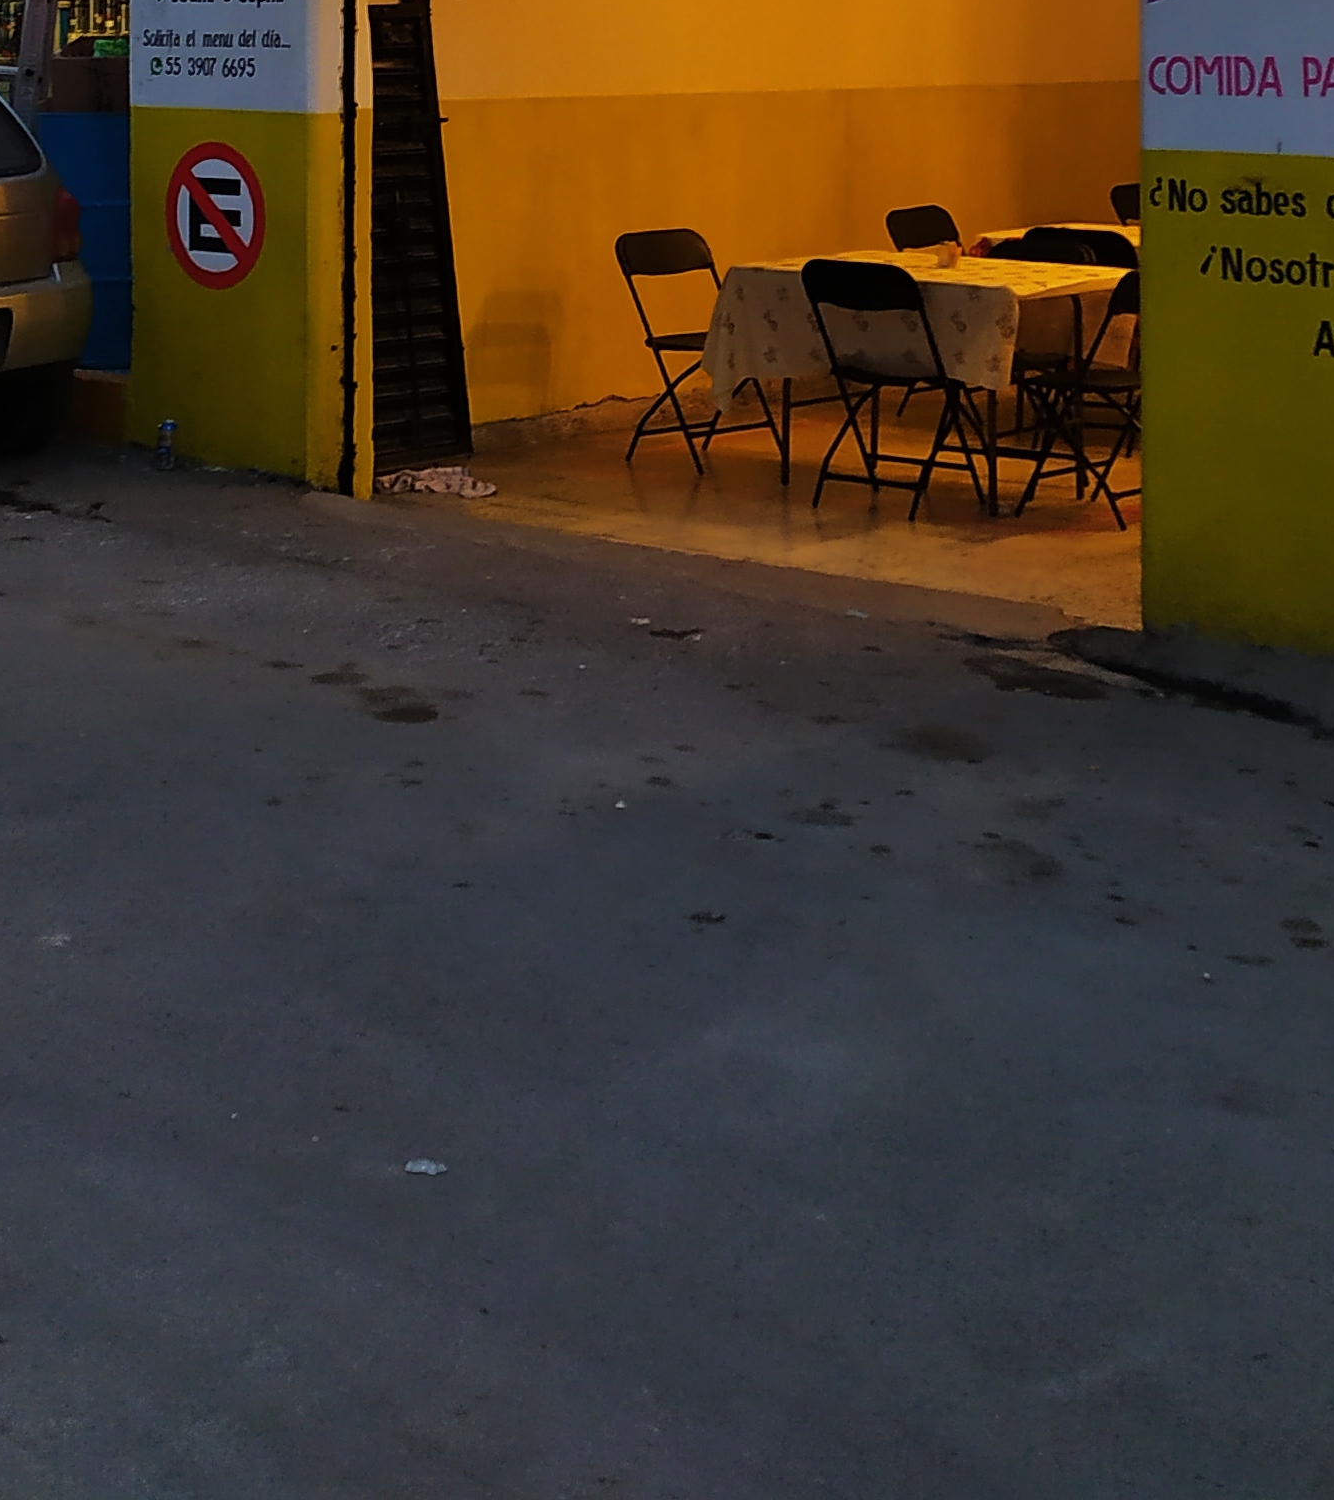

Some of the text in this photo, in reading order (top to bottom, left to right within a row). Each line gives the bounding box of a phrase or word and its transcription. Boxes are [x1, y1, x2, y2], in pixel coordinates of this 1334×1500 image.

[142, 29, 180, 49] Solicita
[185, 29, 196, 48] el
[237, 29, 257, 48] del
[165, 57, 256, 78] 55 3907 6695
[1147, 55, 1283, 98] COMIDA
[1149, 176, 1208, 213] ¿No
[1220, 182, 1307, 218] sabes
